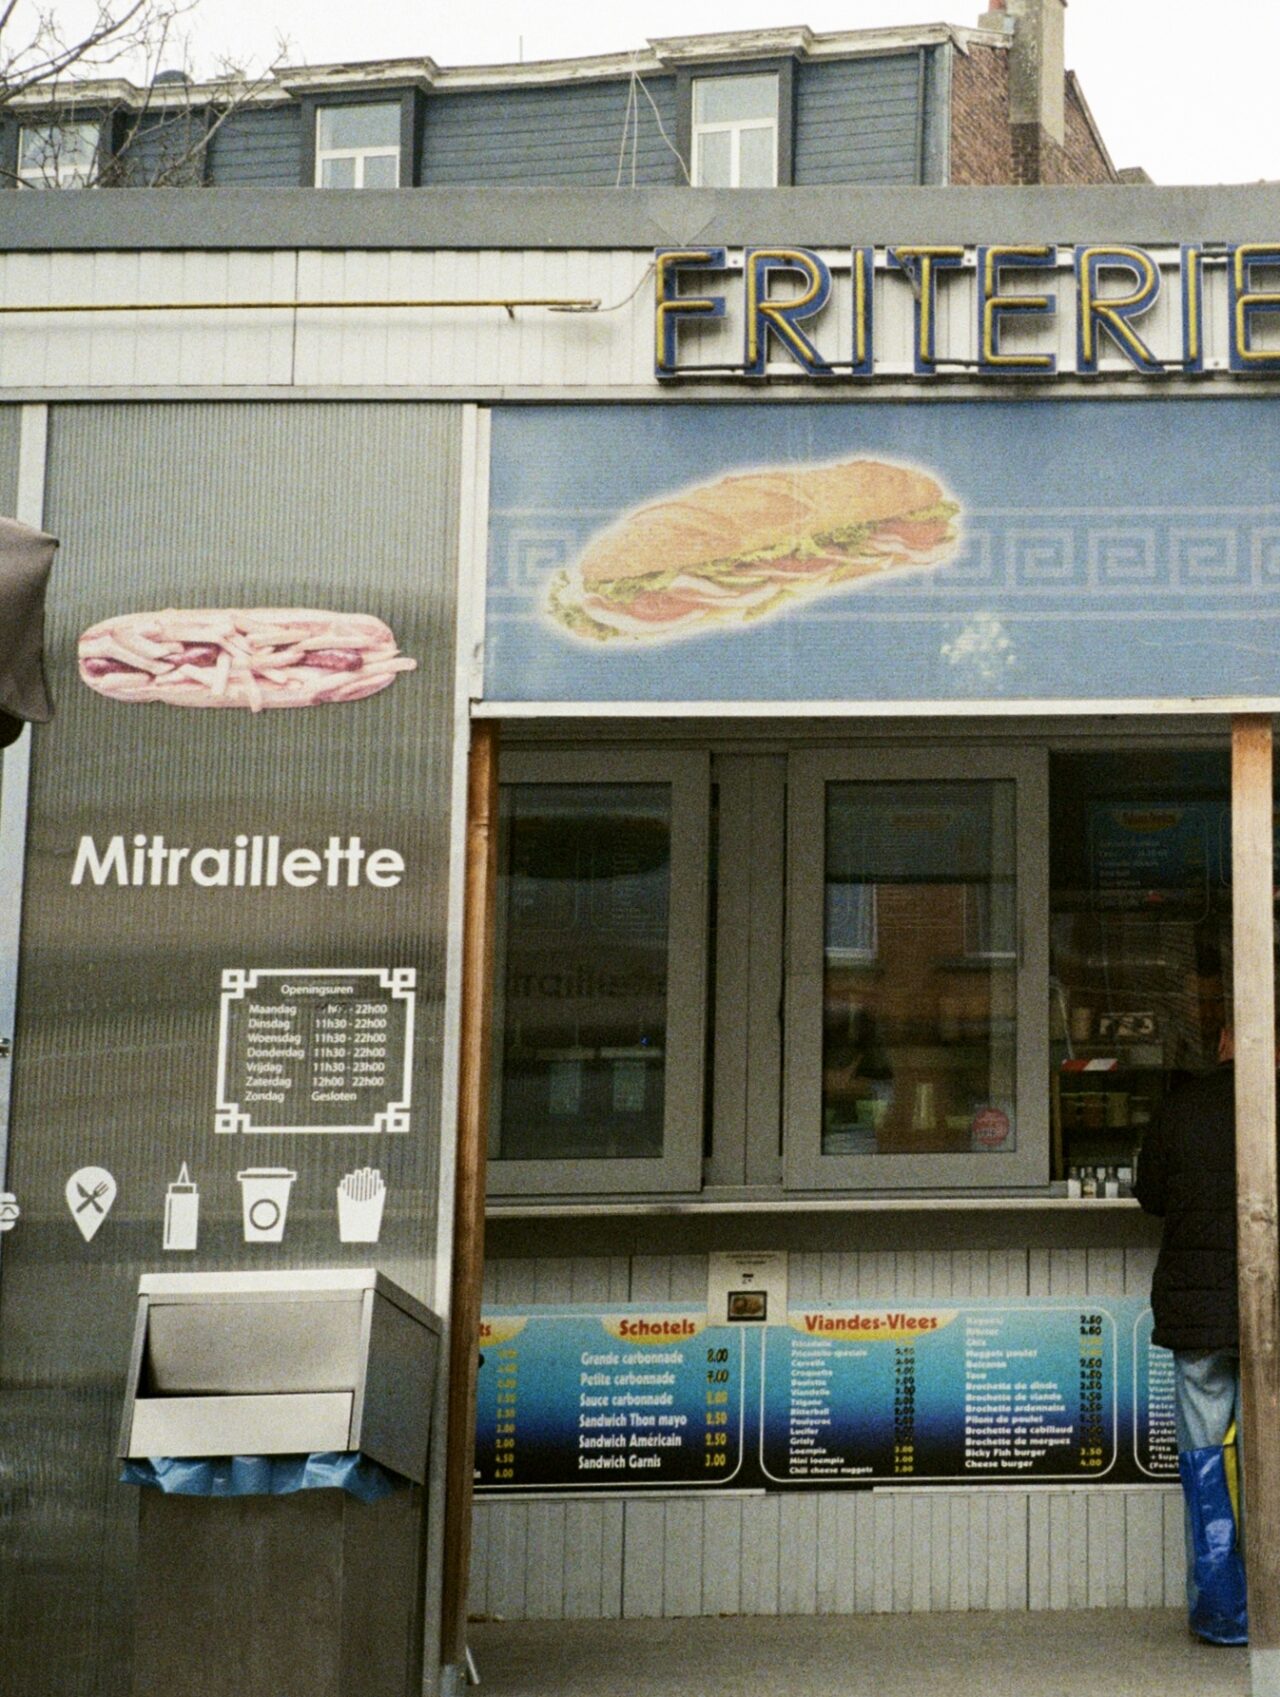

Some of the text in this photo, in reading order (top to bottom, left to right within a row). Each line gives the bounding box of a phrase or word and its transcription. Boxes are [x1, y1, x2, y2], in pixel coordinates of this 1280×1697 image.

[70, 834, 405, 887] Mitraillette
[280, 984, 354, 996] Openingsuren
[249, 1003, 297, 1016] Maandag
[355, 1004, 388, 1014] 22h00
[249, 1018, 386, 1030] Dinsdag 11h30 22h00
[248, 1033, 386, 1046] Woensdag 11h30 22h00
[248, 1047, 386, 1060] Donderdag 11h30 22h00
[246, 1062, 385, 1074] Vrijdag 11h30 23h00
[246, 1076, 384, 1089] Zaterdag 12h00 22h00
[245, 1090, 357, 1104] Zondag Gesloten
[619, 1319, 695, 1336] Schotels
[804, 1314, 938, 1332] Viandes-Vlees
[580, 1352, 619, 1365] Grande
[622, 1350, 684, 1364] carbonnade
[580, 1372, 610, 1386] Petite
[614, 1371, 677, 1385] carbonnade
[580, 1392, 674, 1407] Sauce carbonnade
[579, 1413, 627, 1428] Sandwich
[630, 1412, 656, 1426] Thon
[658, 1415, 688, 1428] mayo
[578, 1434, 626, 1448] Sandwich
[629, 1432, 682, 1447] Américain
[994, 1448, 1012, 1456] Fish
[1014, 1448, 1046, 1458] burger
[578, 1455, 626, 1470] Sandwich
[628, 1454, 662, 1468] Garnis
[790, 1456, 808, 1464] Mini
[965, 1460, 998, 1468] Cheese
[1001, 1459, 1034, 1469] burger
